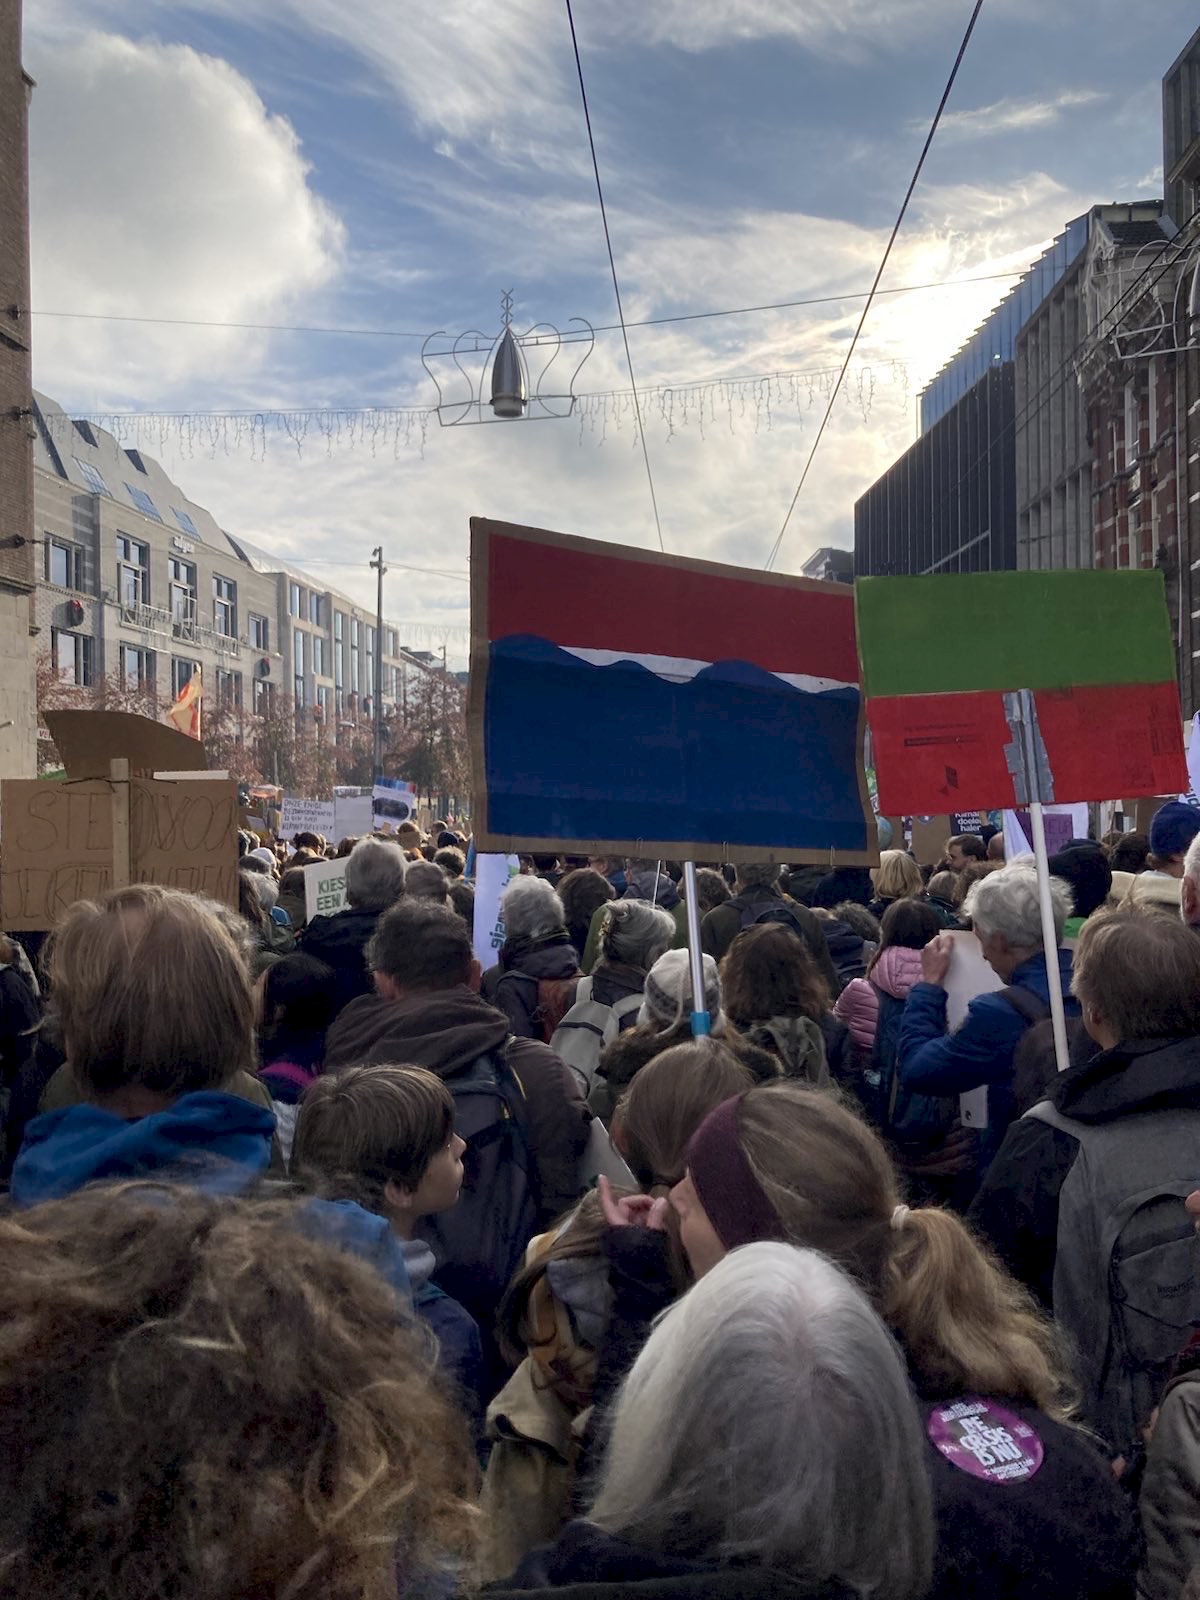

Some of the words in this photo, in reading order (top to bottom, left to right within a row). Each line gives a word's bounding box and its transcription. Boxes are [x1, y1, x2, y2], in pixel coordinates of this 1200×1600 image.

[957, 817, 982, 825] doele
[318, 876, 345, 894] KIES
[316, 894, 341, 911] EEN
[960, 1427, 1014, 1450] CRISIS
[973, 1446, 996, 1466] IS
[991, 1441, 1023, 1462] NU
